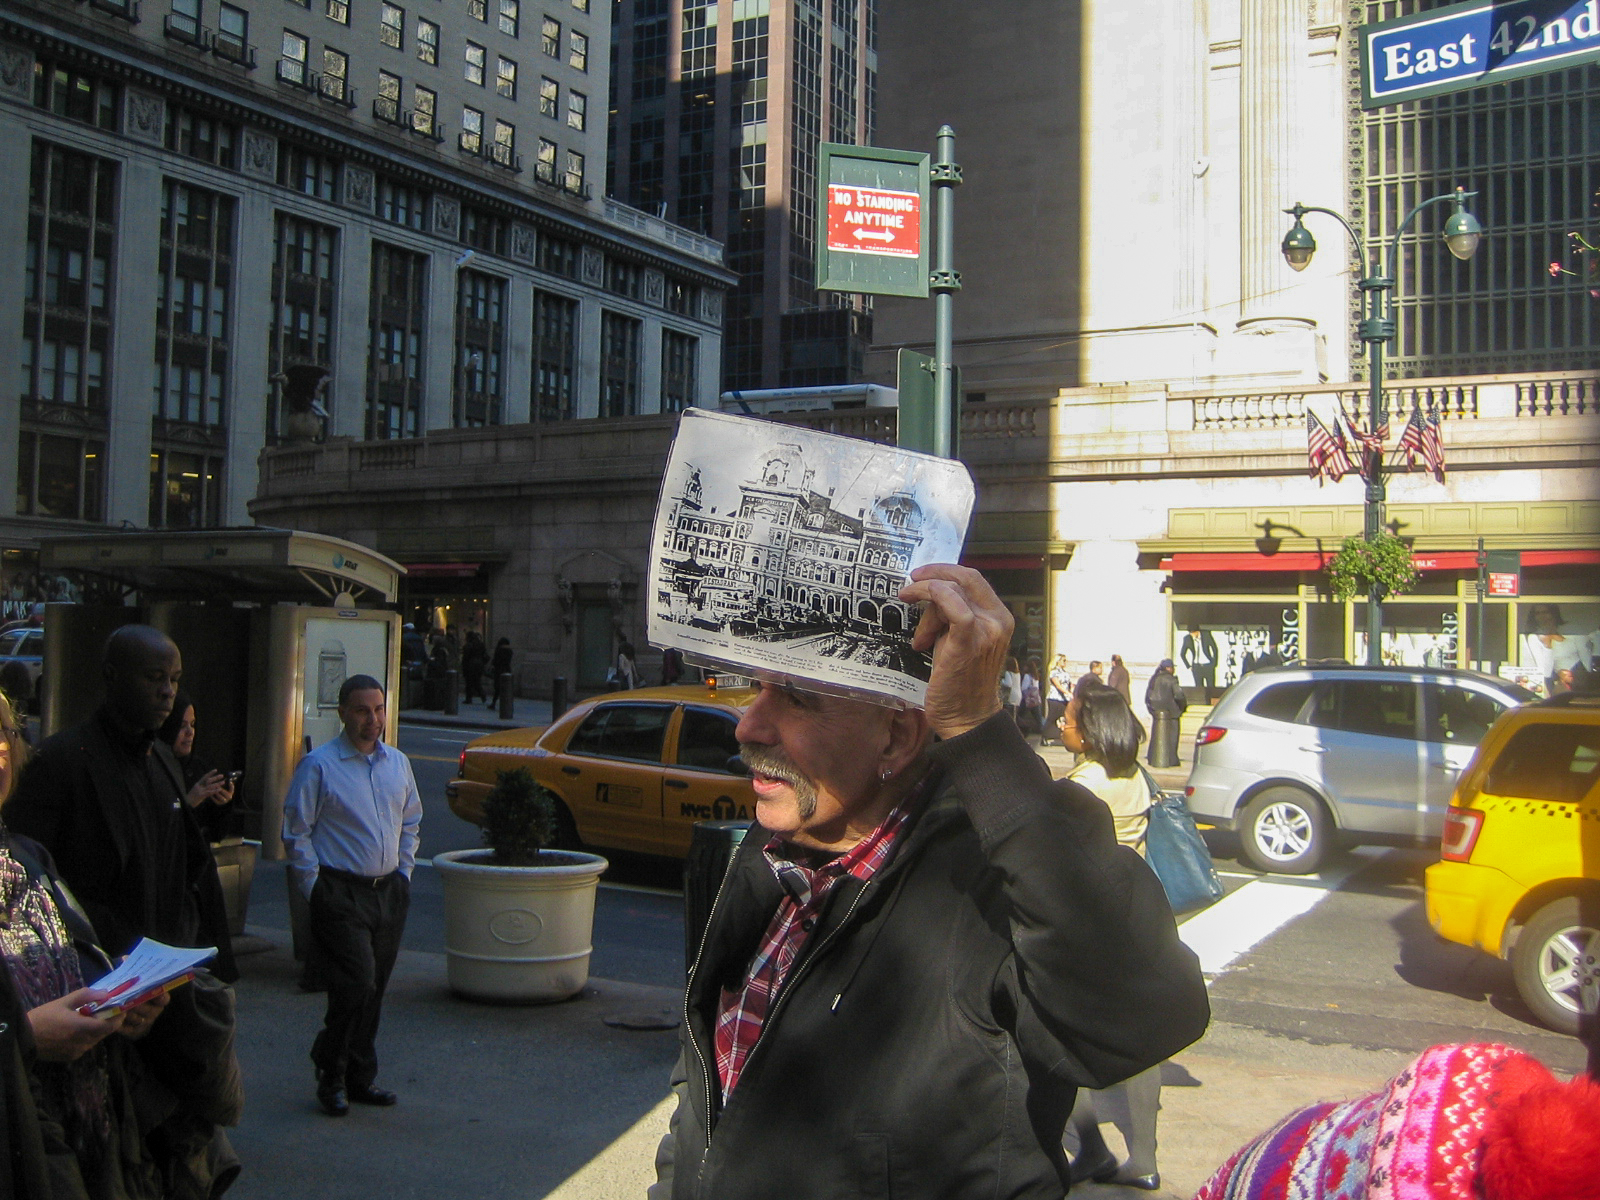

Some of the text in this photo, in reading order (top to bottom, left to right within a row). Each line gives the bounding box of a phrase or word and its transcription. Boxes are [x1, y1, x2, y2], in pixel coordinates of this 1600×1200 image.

[1383, 0, 1600, 82] East 42nd
[834, 191, 913, 212] NO STANDING
[843, 210, 905, 229] ANYTIME
[680, 802, 711, 819] NYC
